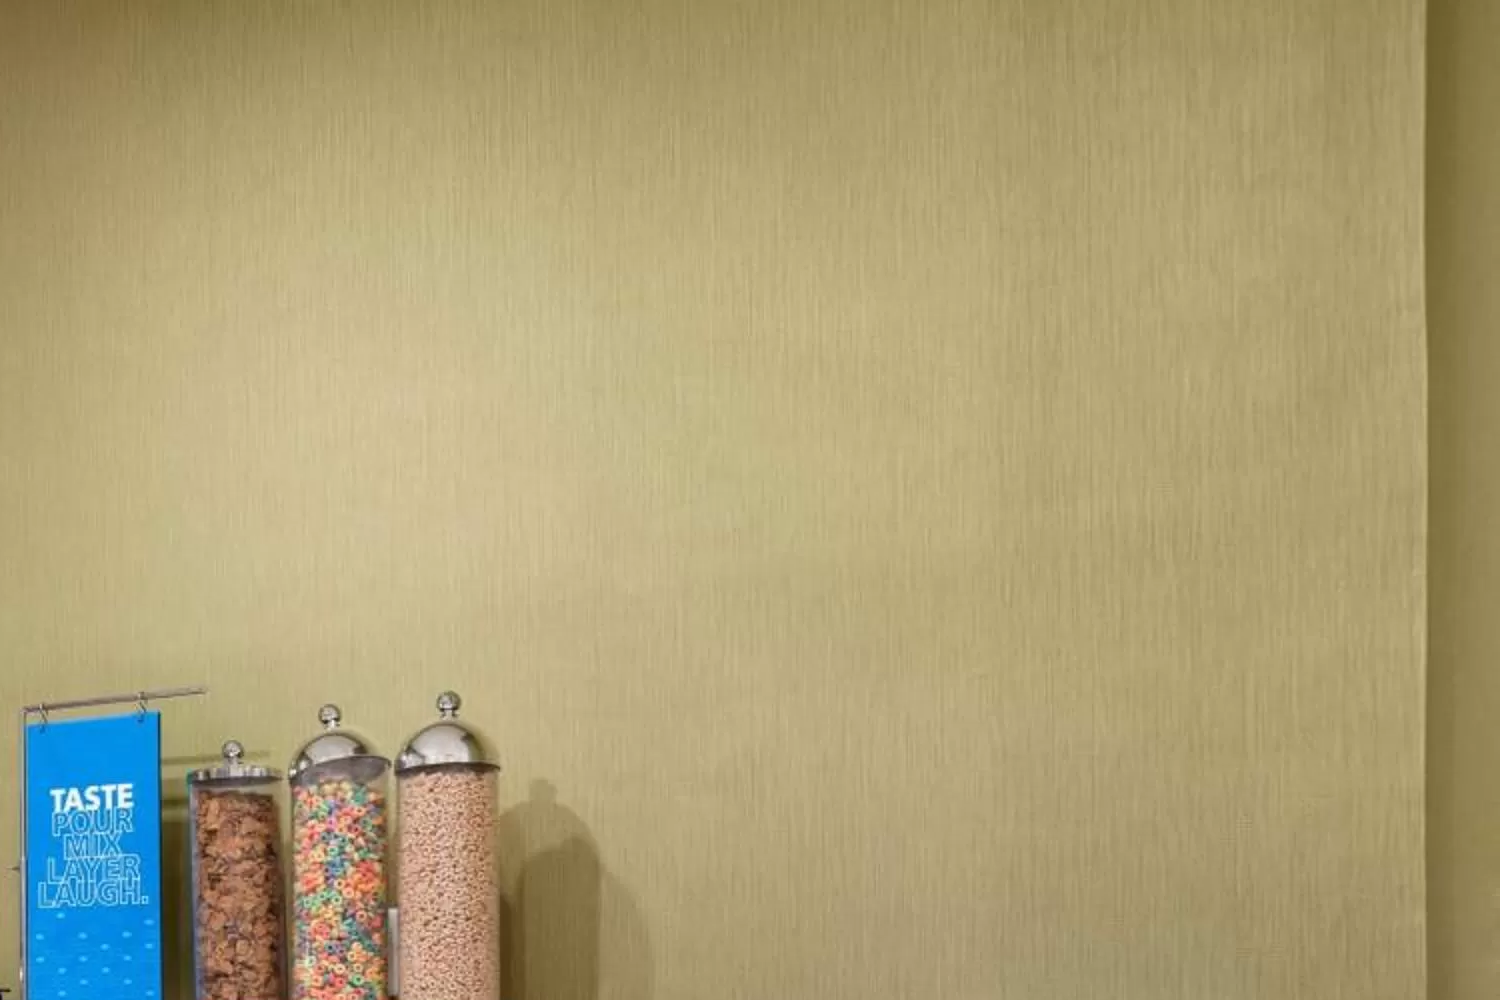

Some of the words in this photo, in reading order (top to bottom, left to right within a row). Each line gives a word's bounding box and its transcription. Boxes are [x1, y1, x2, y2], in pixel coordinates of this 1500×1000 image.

[49, 783, 134, 812] TASTE
[51, 807, 133, 837] POUR
[64, 830, 122, 860] MIX
[48, 853, 141, 884] LAYER
[38, 877, 149, 908] LAUGH.
